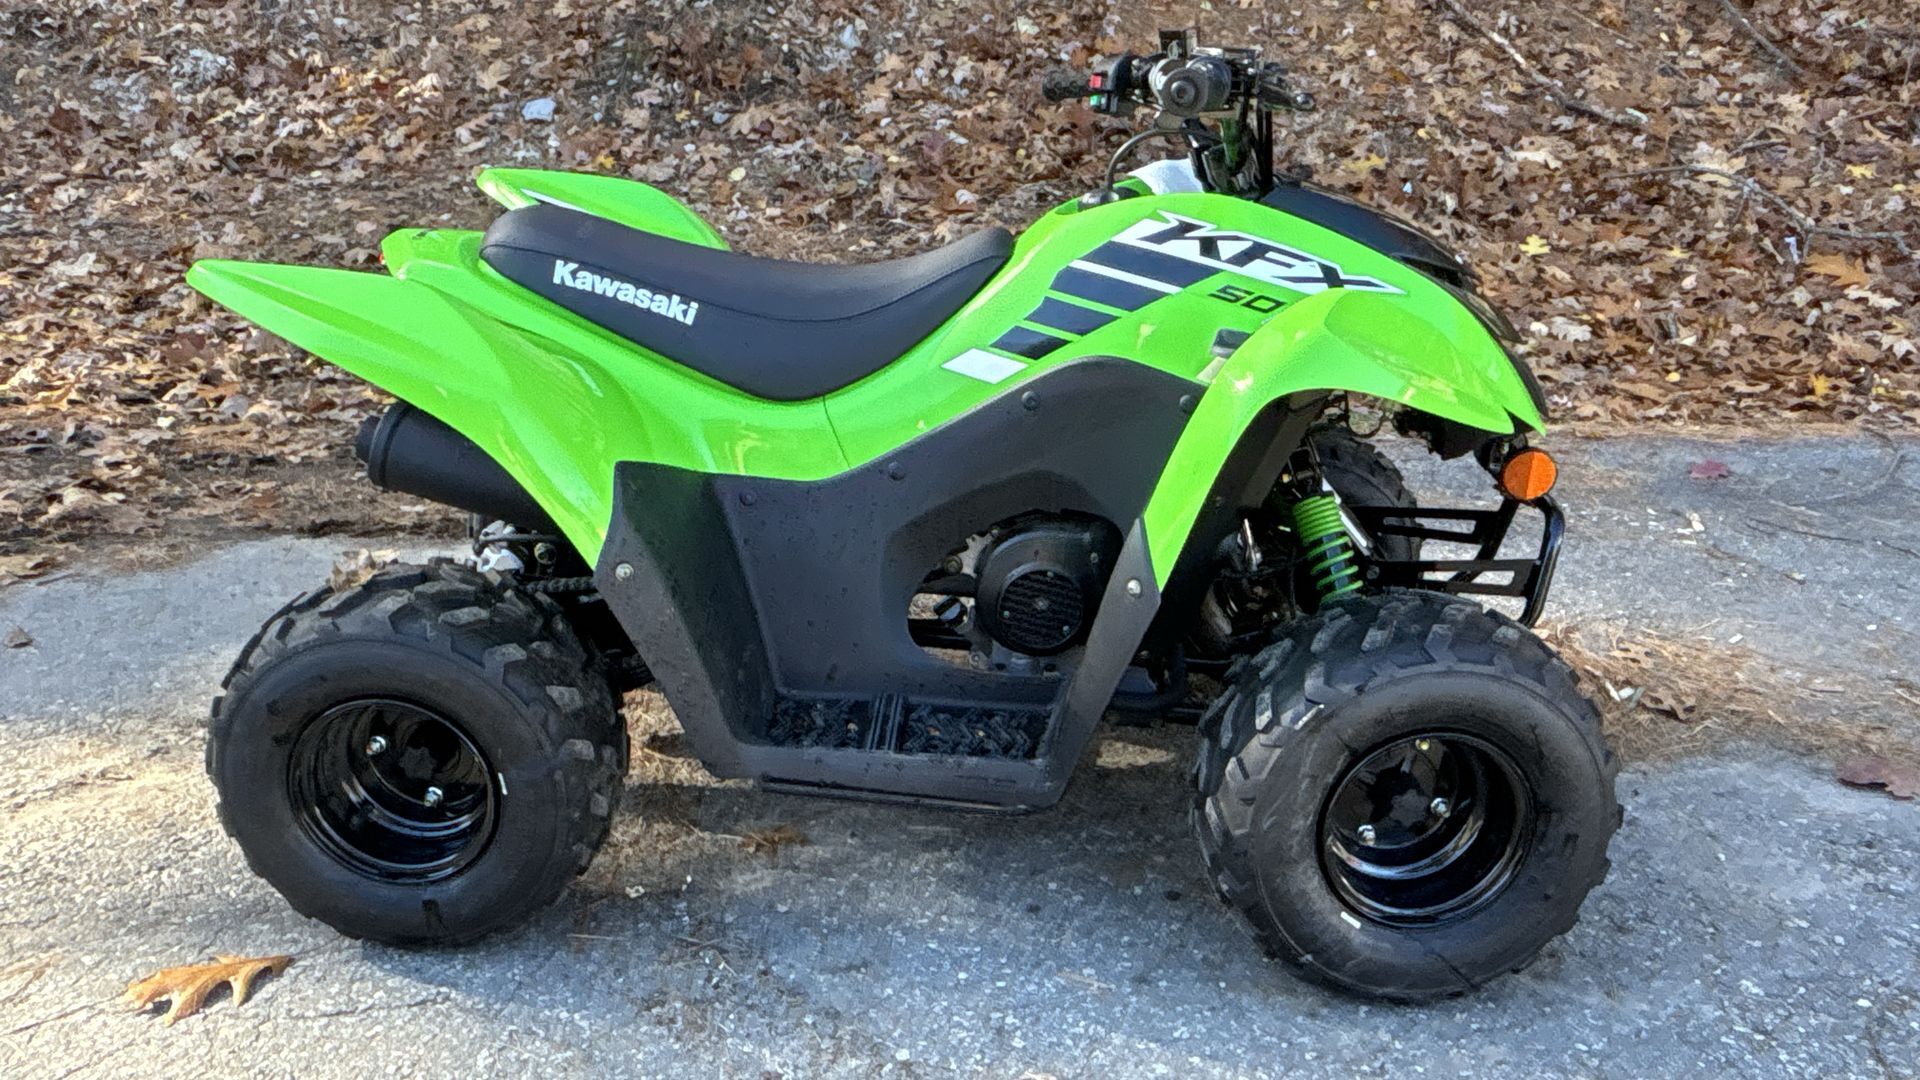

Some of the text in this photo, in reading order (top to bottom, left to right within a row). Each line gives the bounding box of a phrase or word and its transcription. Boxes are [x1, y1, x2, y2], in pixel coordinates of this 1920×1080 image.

[1130, 211, 1400, 292] KFX
[552, 259, 699, 326] Kawasaki
[1208, 284, 1288, 314] 50
